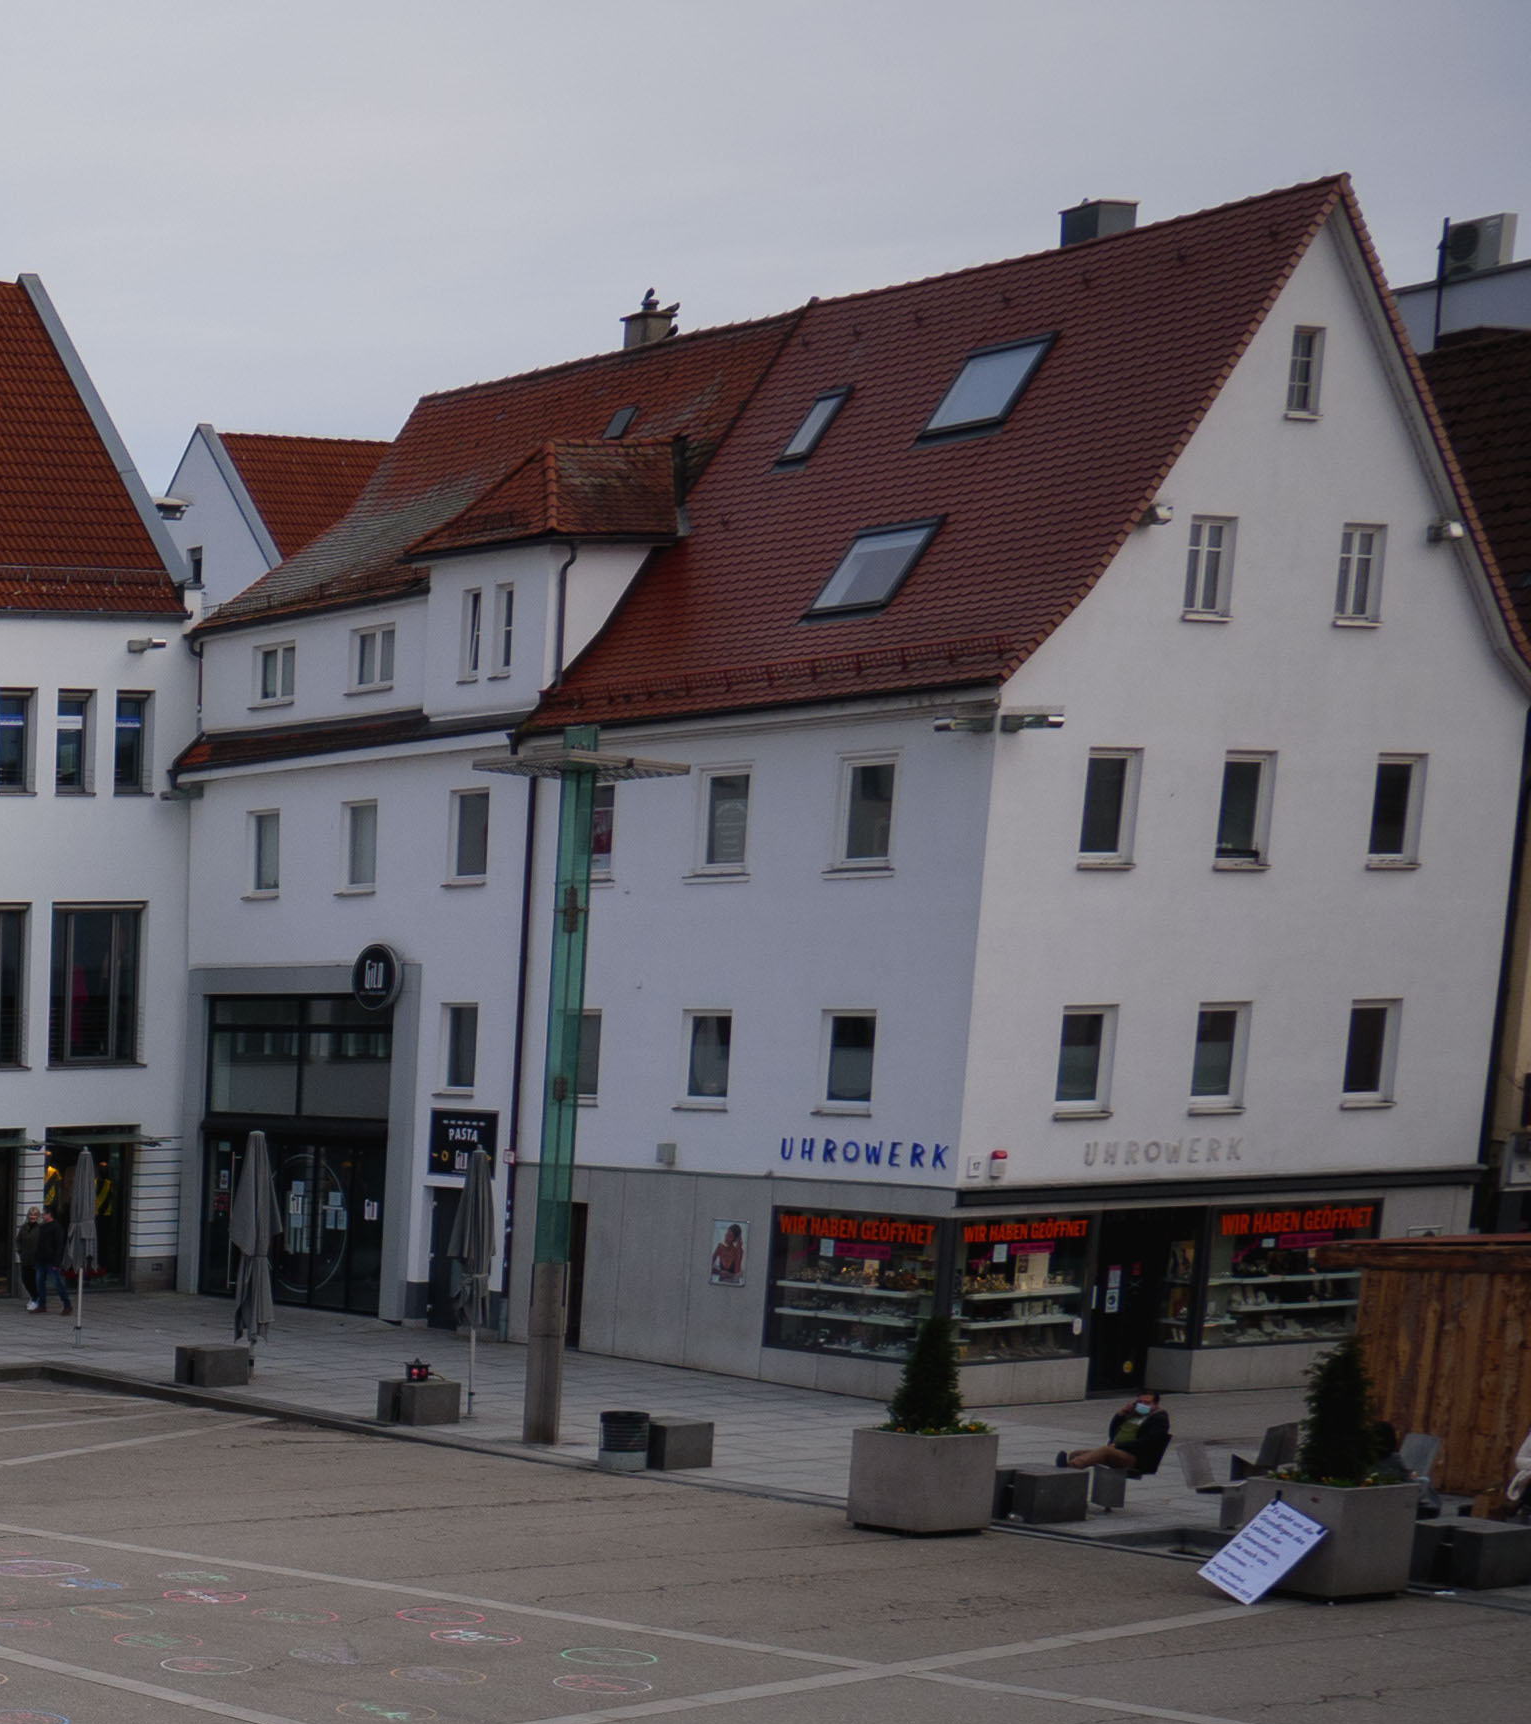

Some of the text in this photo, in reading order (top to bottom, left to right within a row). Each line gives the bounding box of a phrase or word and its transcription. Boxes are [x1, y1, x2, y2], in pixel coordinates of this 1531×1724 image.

[448, 1127, 479, 1142] PASTA
[780, 1138, 950, 1170] UHROWERK
[1083, 1137, 1244, 1168] UHROWERK
[779, 1214, 936, 1245] WIR HABEN GEÖFFNET
[963, 1218, 1089, 1242] WIR HABEN GEÖFFNET
[1221, 1204, 1374, 1236] WIR HABEN GEÖFFNET
